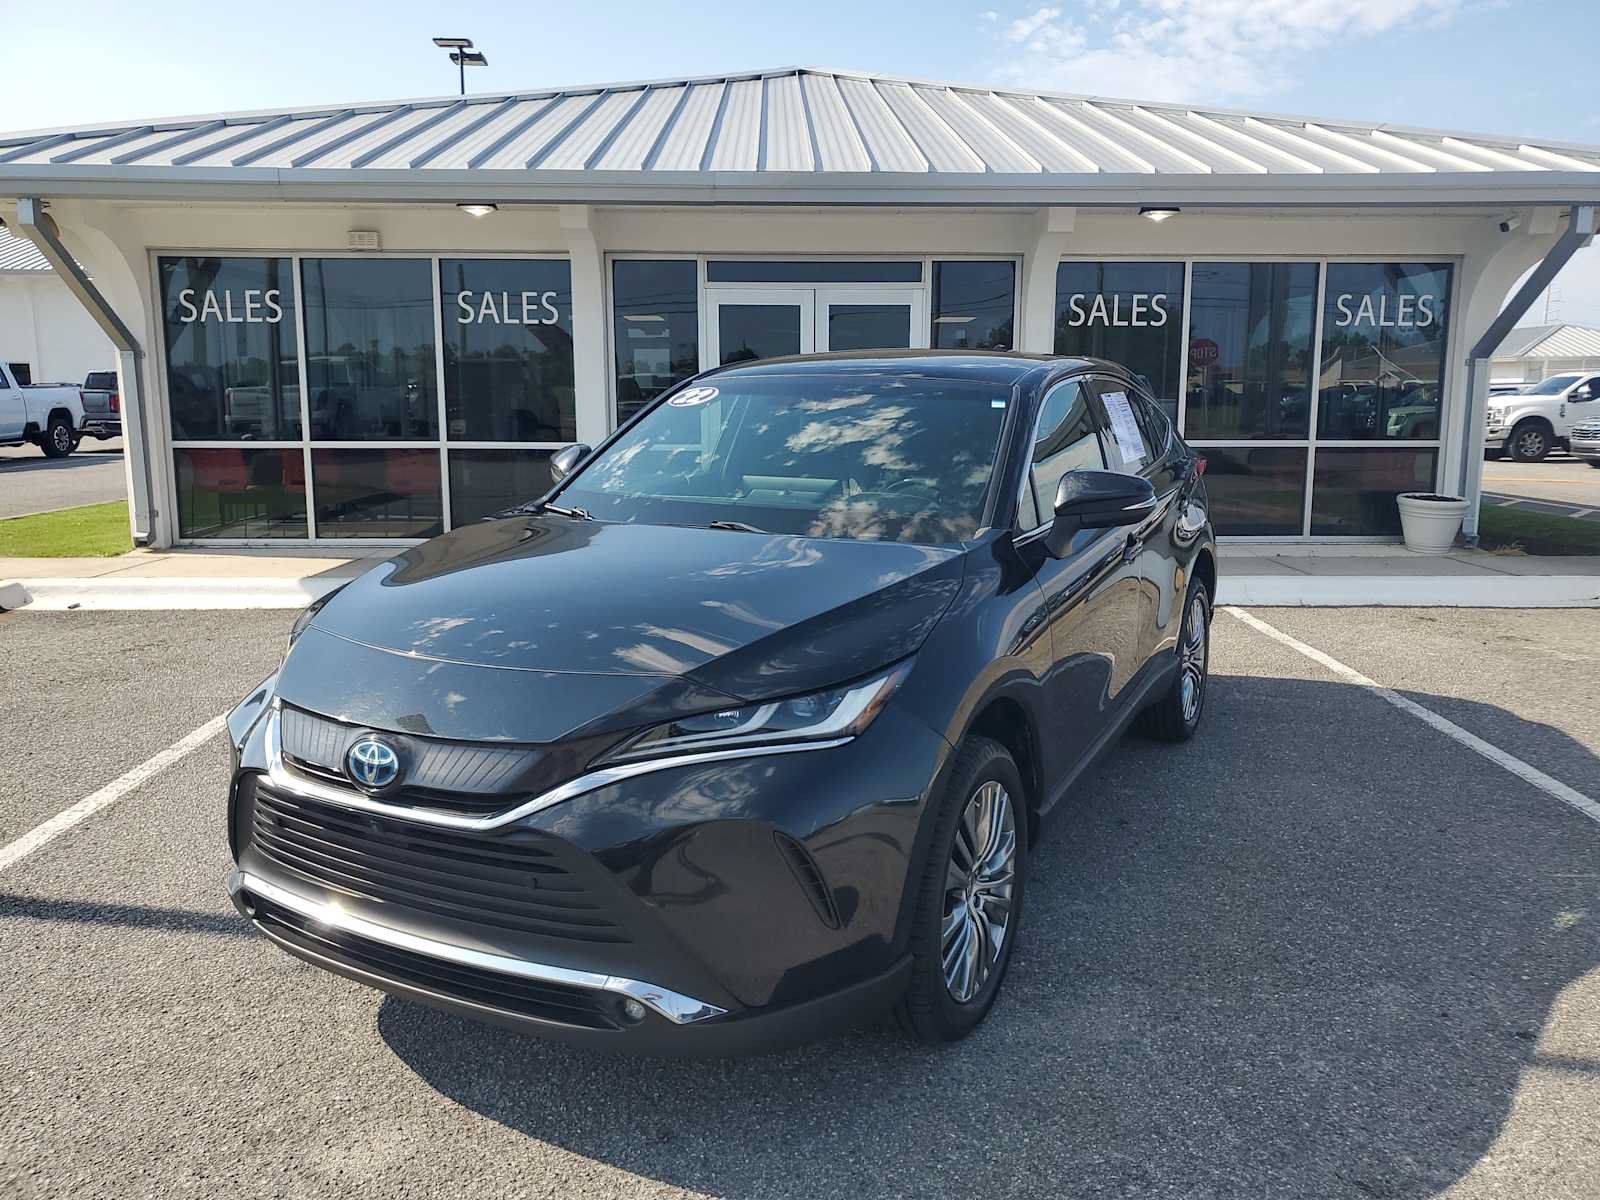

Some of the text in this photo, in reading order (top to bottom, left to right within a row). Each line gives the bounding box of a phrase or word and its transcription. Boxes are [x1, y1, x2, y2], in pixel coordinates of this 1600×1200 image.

[179, 288, 283, 323] SALES
[457, 290, 559, 325] SALES
[1068, 293, 1167, 327] SALES
[1335, 294, 1434, 327] SALES
